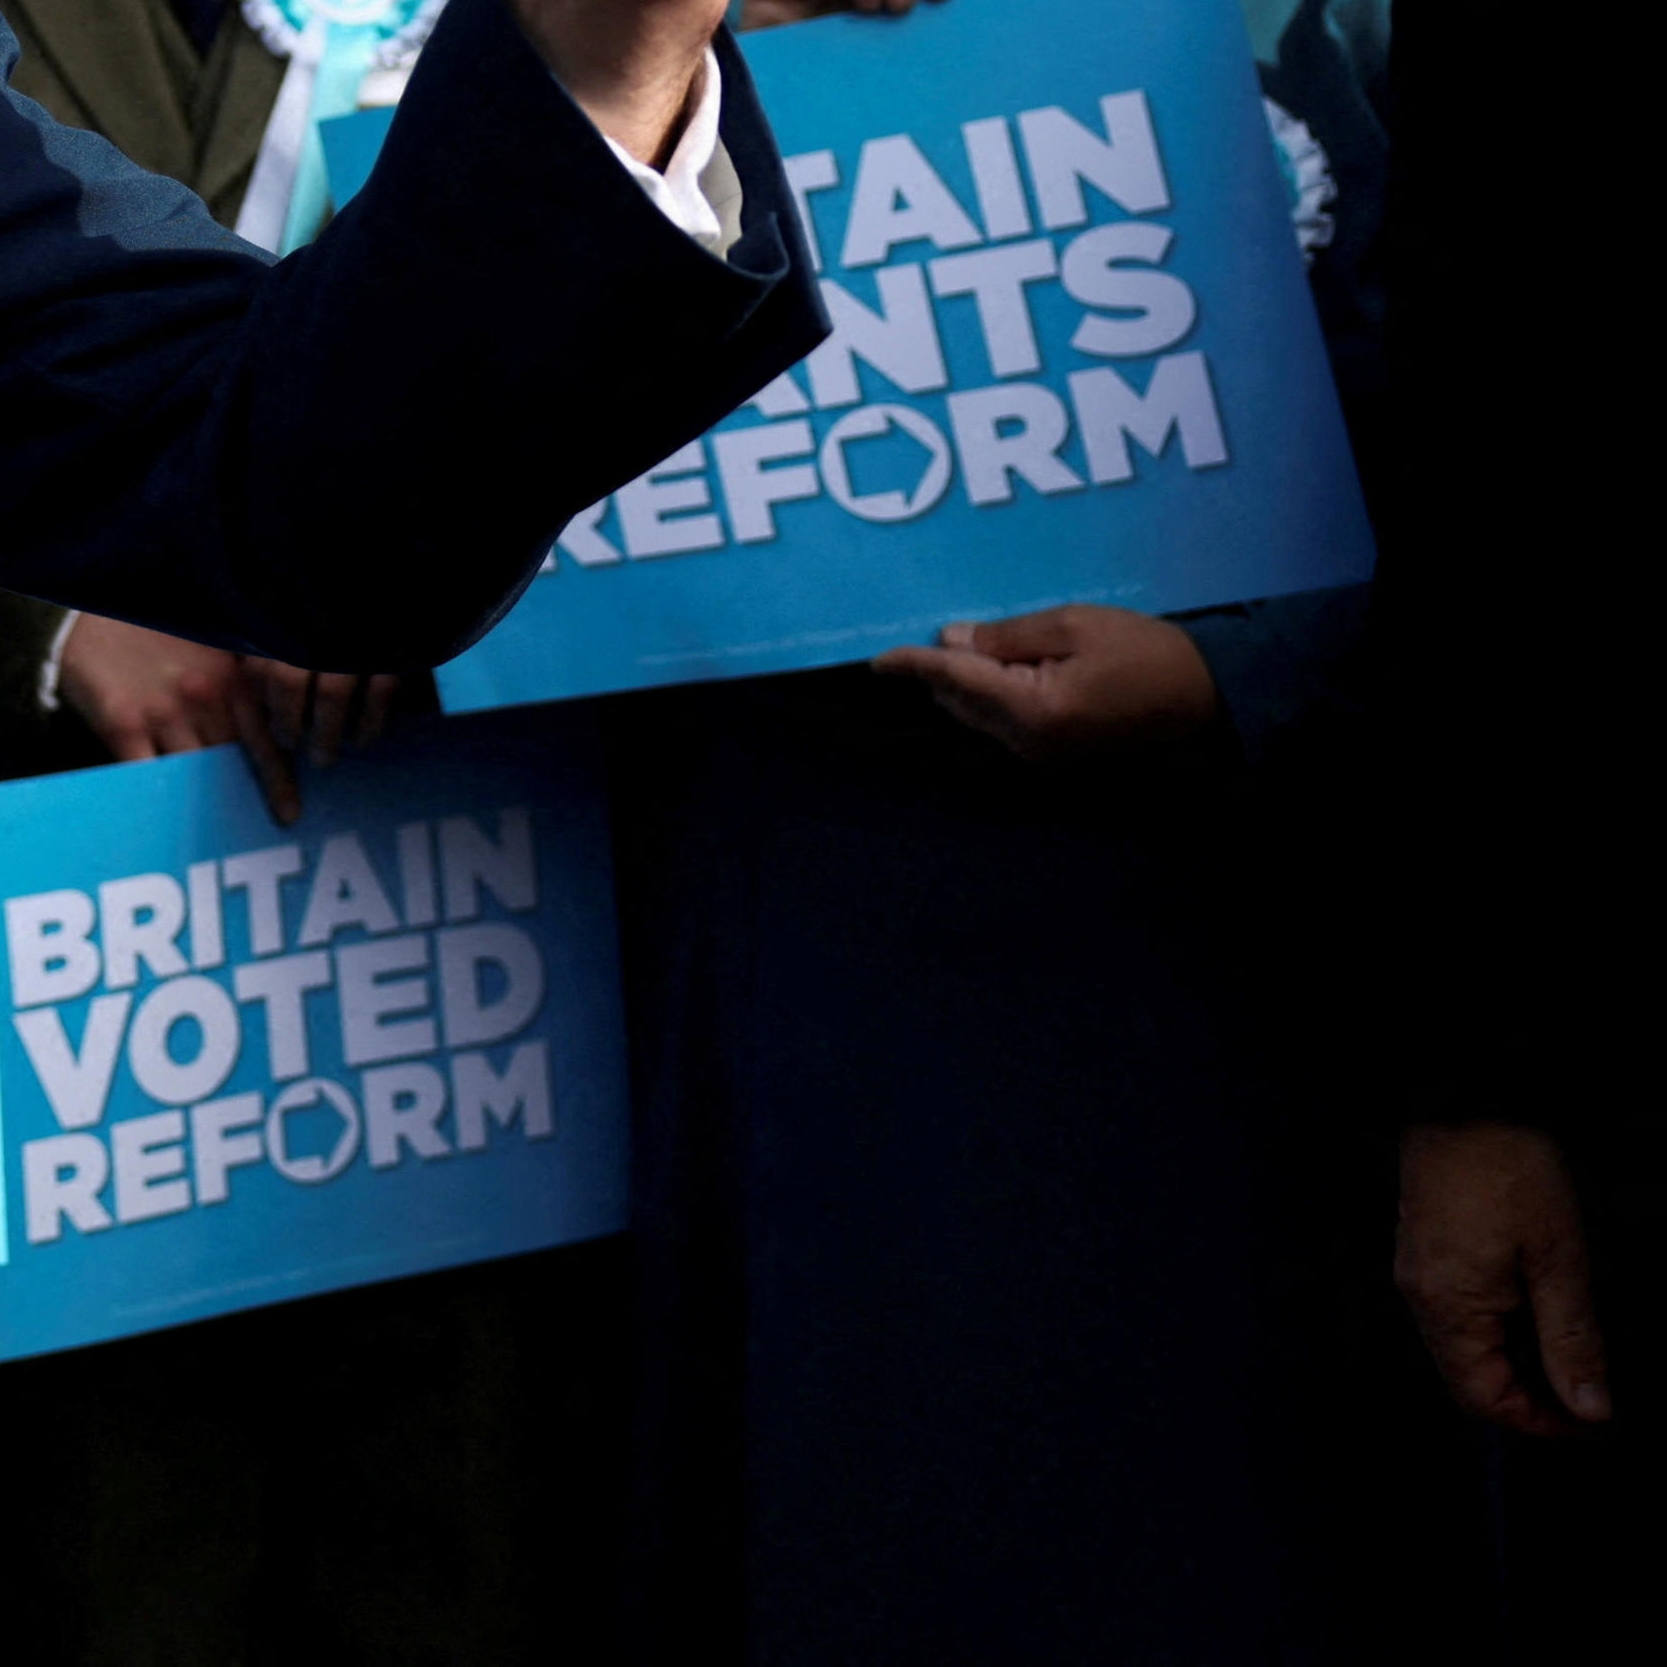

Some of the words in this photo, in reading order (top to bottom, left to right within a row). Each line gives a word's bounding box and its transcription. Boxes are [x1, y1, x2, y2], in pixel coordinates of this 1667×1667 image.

[5, 808, 539, 1009] BRITAIN
[14, 925, 544, 1132] VOTED
[22, 1039, 553, 1244] REFORM
